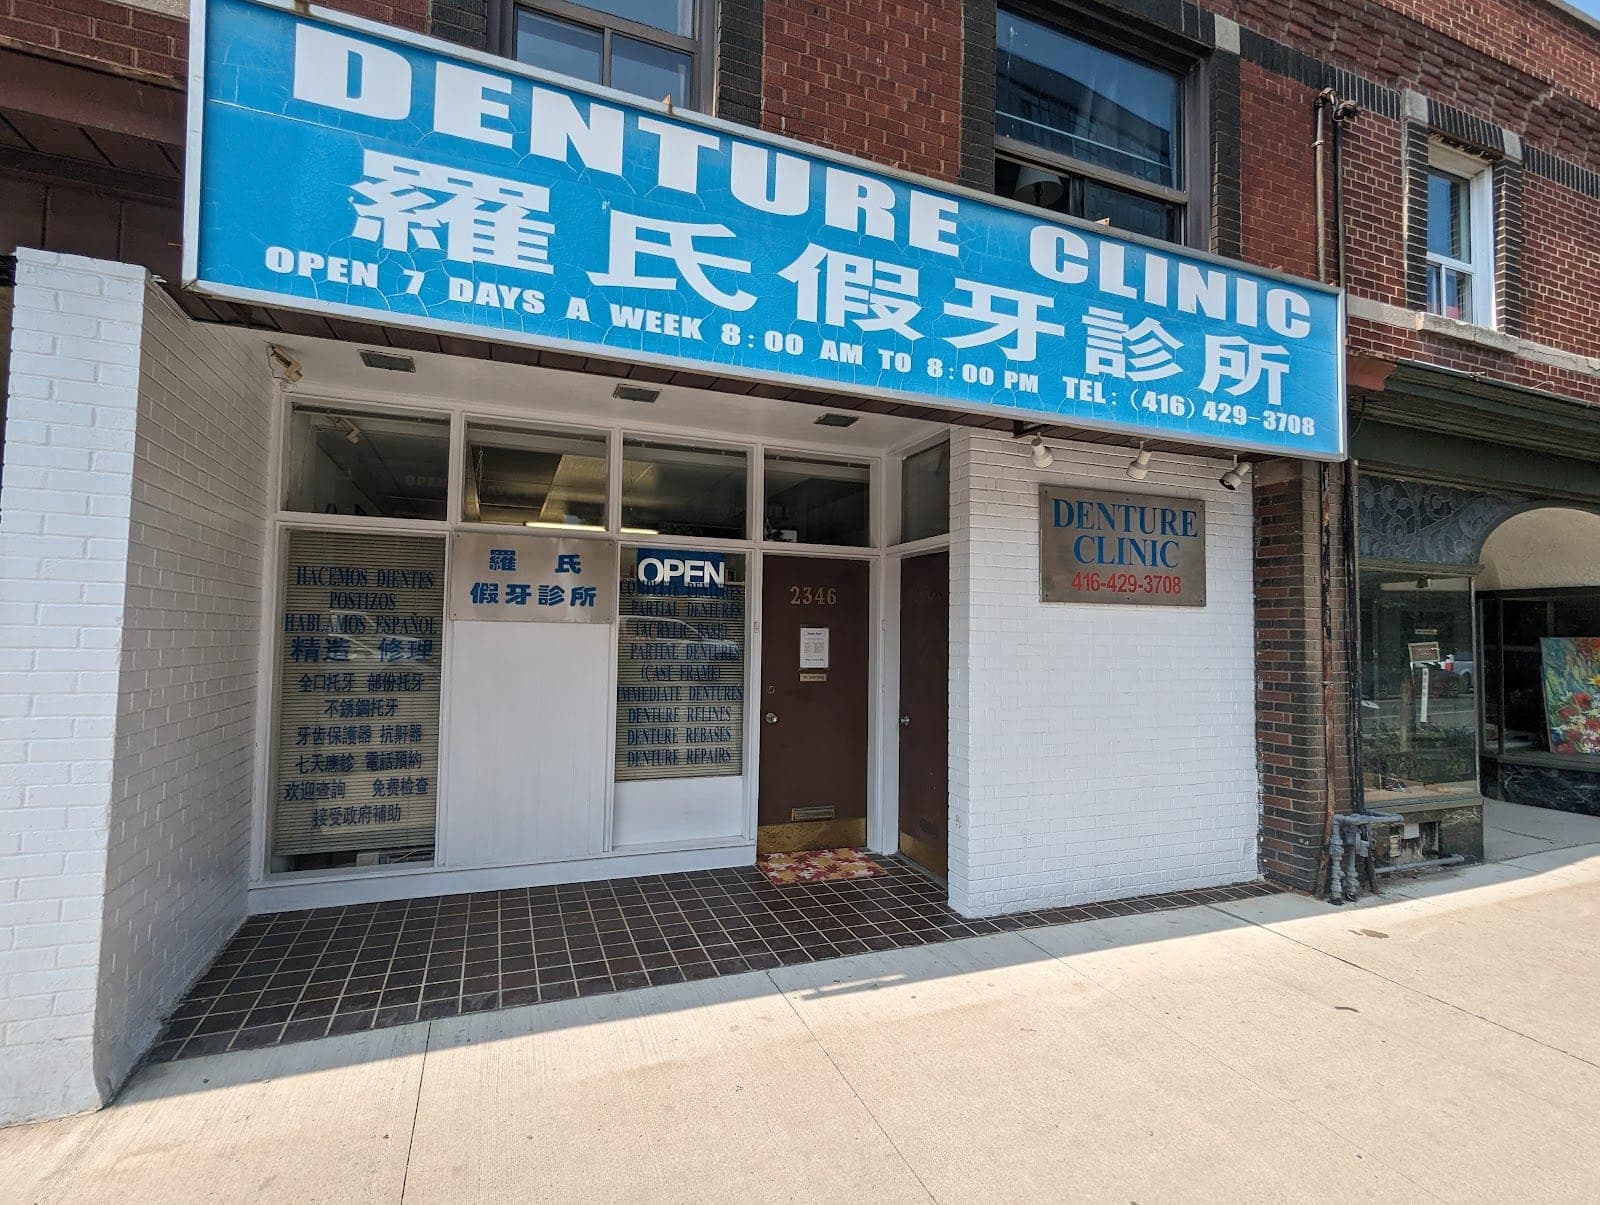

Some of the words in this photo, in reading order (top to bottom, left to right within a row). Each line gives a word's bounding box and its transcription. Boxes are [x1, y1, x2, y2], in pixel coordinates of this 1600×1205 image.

[293, 22, 959, 258] DENTURE
[1029, 225, 1311, 339] CLINIC
[350, 148, 1291, 407] 羅氏假牙診所
[264, 246, 379, 289] OPEN
[403, 269, 425, 295] 7
[448, 276, 546, 315] DAYS
[565, 297, 591, 322] A
[609, 303, 702, 341] WEEK
[819, 339, 864, 366] AM
[878, 349, 912, 373] TO
[1004, 370, 1039, 394] PM
[1062, 375, 1117, 407] TEL:
[1130, 388, 1195, 419] (416)
[1202, 400, 1316, 437] 429-3708
[1052, 498, 1198, 538] DENTURE
[1073, 535, 1180, 569] CLINIC
[296, 565, 368, 587] HACEMOS
[376, 568, 434, 590] DIENTES
[637, 557, 726, 589] OPEN
[1071, 571, 1182, 595] 416-429-3708
[329, 590, 396, 611] POSTIZOS
[470, 582, 597, 608] 假牙診所
[790, 585, 838, 606] 2346
[687, 602, 742, 618] DENTURES
[284, 612, 366, 635] HABLAMOS
[375, 612, 437, 635] ESPAÑOL
[378, 637, 434, 663] 修理
[630, 642, 679, 661] PARTIAL
[686, 643, 741, 662] DENTURES
[298, 672, 355, 693] 全口托牙
[367, 672, 425, 693] 部份托牙
[616, 685, 682, 702] IMMEDIATE
[688, 685, 744, 702] DENTURES
[628, 706, 680, 724] DENTURE
[687, 705, 732, 723] RELINES
[627, 727, 679, 746] DENTURE
[686, 726, 731, 744] REBASES
[365, 750, 422, 772] 電話預約
[627, 749, 679, 768] DENTURE
[686, 747, 731, 765] REPAIRS
